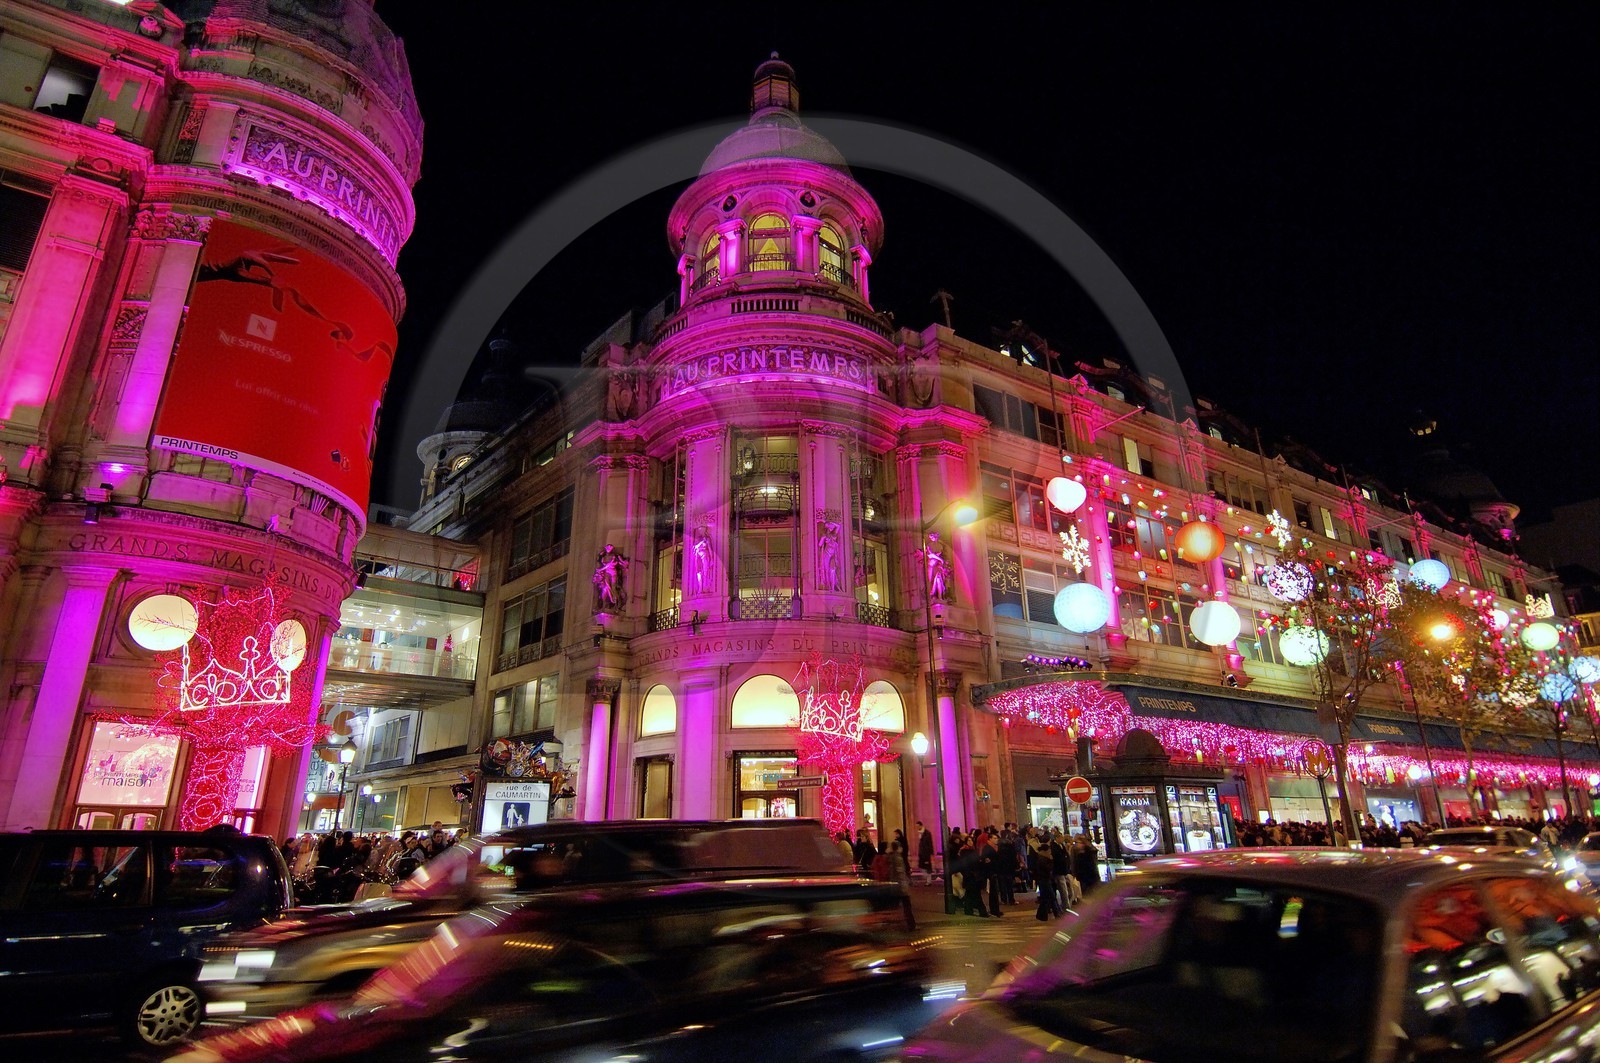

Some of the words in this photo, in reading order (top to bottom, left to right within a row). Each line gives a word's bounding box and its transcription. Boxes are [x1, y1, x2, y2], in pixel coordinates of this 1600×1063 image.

[263, 142, 314, 178] AU
[218, 329, 292, 363] NESPRESSO
[673, 361, 699, 389] AU
[706, 349, 861, 379] PRINTEMPS
[160, 436, 239, 460] PRINTEMPS
[68, 533, 189, 560] GRANDS
[210, 550, 319, 594] MAGASINS
[639, 646, 680, 667] GRANDS
[692, 639, 776, 656] MAGASINS
[793, 639, 815, 652] DU
[1137, 696, 1197, 713] PRINTEMPS
[101, 777, 152, 788] maison
[495, 791, 541, 799] CAUMARTIN
